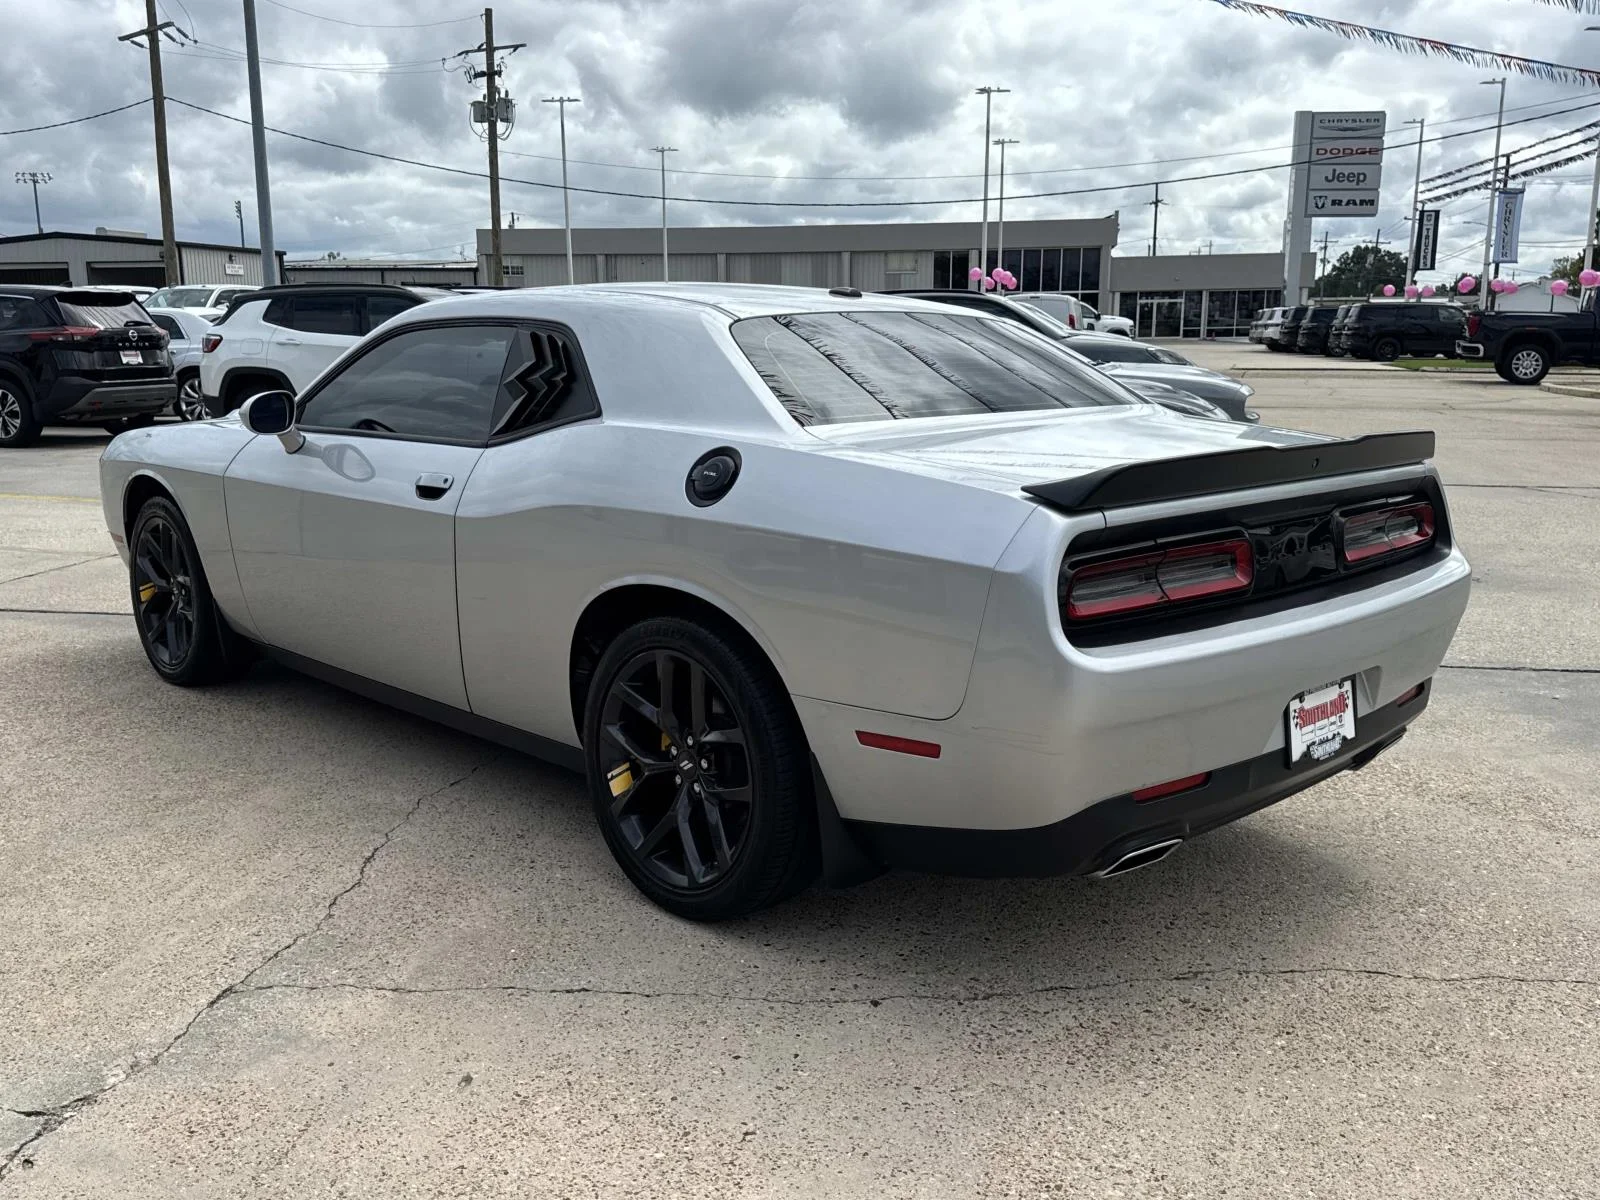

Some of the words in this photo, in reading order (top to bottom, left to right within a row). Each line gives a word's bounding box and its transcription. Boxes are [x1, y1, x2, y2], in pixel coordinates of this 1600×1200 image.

[1316, 147, 1380, 156] DODGE
[1324, 168, 1367, 185] Jeep
[1330, 198, 1375, 207] RAM
[1422, 228, 1431, 267] TRUCKS
[1298, 691, 1346, 729] SOUTHLAND
